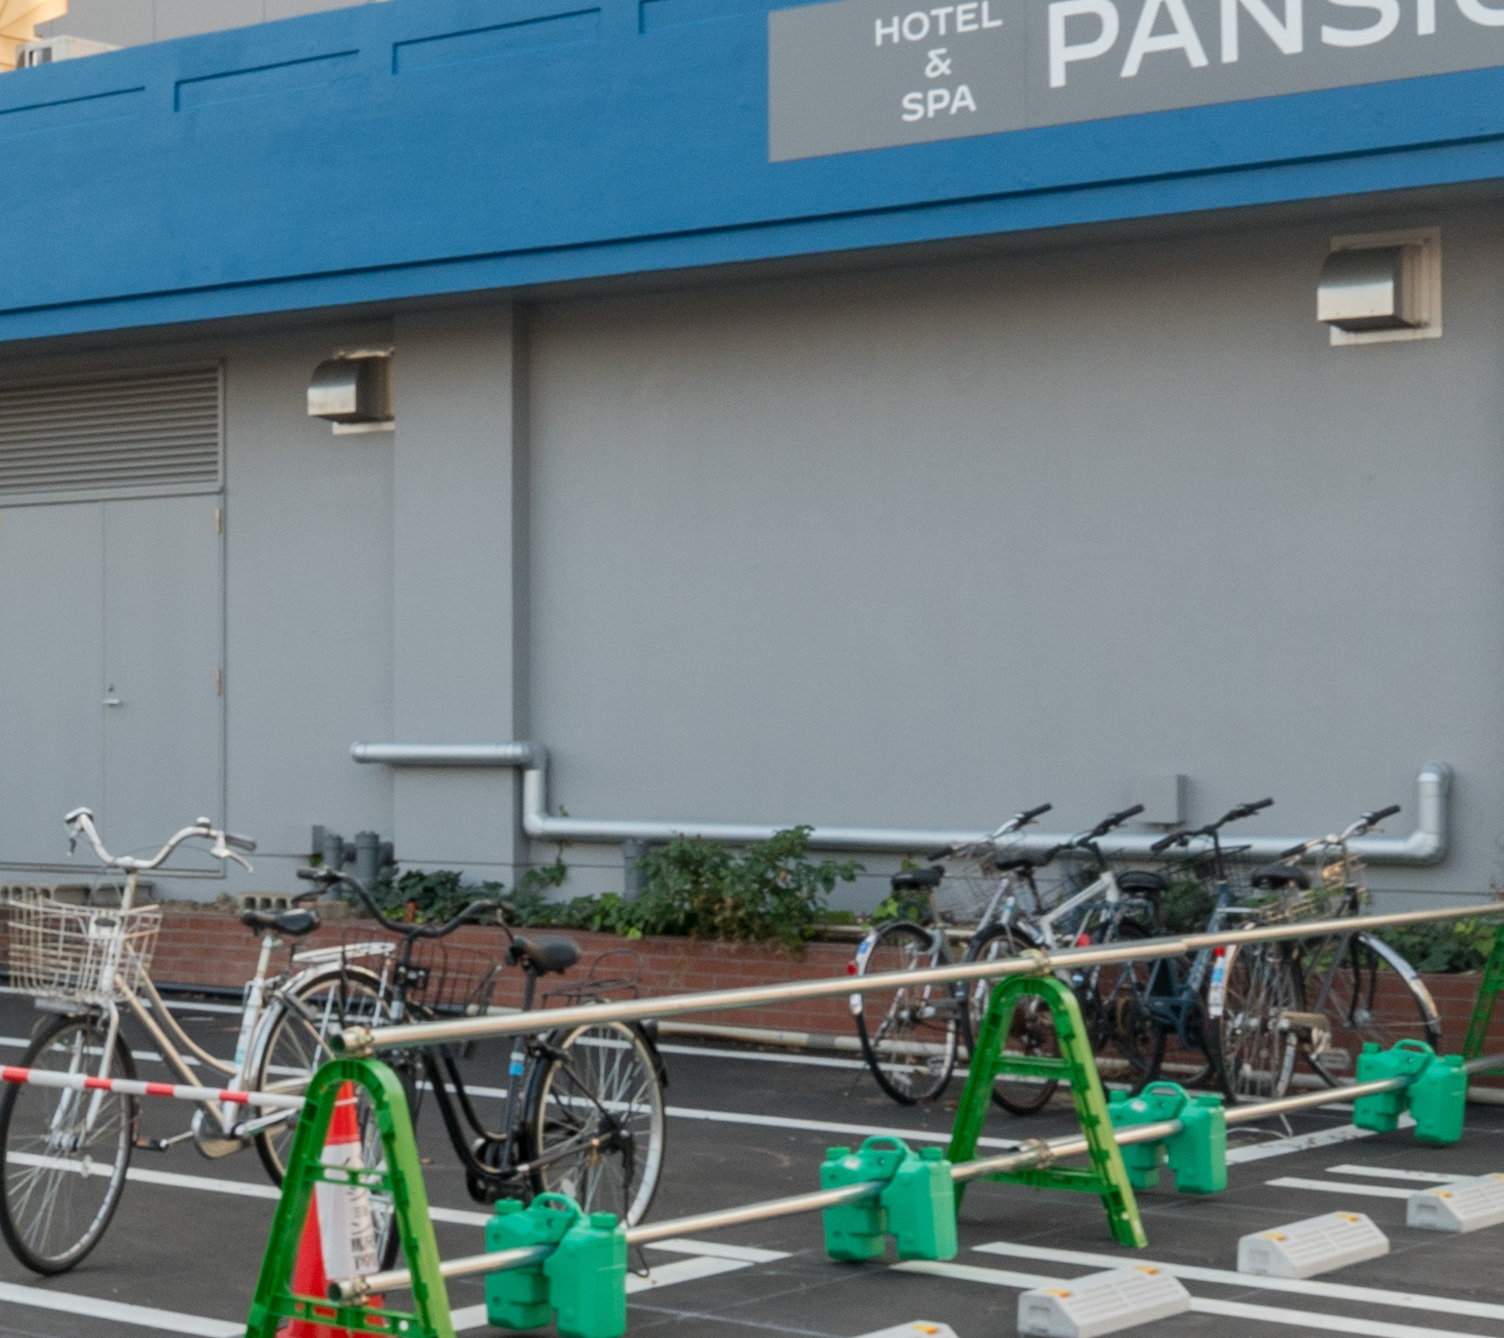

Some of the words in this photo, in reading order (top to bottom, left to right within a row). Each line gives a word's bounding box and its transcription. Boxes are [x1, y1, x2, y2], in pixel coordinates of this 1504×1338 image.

[874, 0, 1003, 47] HOTEL
[923, 47, 952, 79] &
[900, 84, 977, 122] SPA
